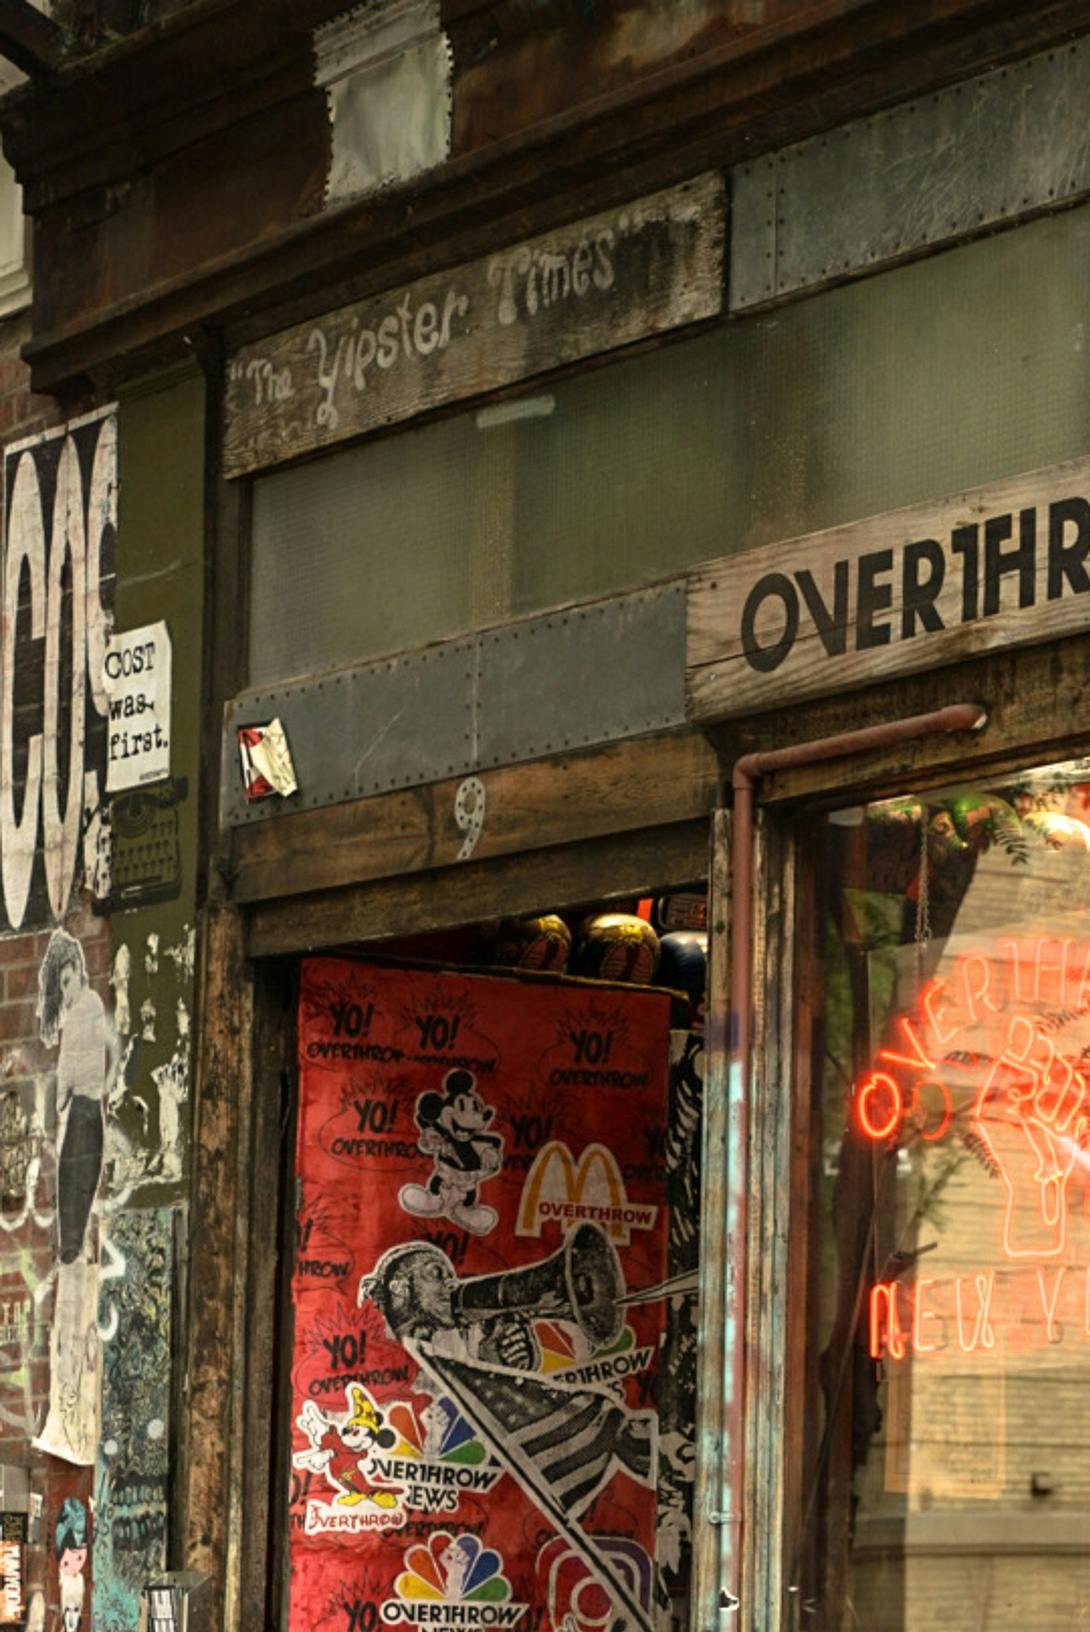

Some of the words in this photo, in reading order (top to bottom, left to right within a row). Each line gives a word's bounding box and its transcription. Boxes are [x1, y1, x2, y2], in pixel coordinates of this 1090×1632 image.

[307, 292, 469, 429] Yipster
[104, 641, 156, 680] COST
[109, 723, 168, 761] first.
[454, 776, 486, 861] 9
[330, 1003, 375, 1038] YO!
[415, 1014, 460, 1050] YO!
[569, 1029, 614, 1065] YO!
[353, 1099, 398, 1134] YO!
[331, 1138, 429, 1159] OVERTHRO
[538, 1202, 652, 1225] OVERTHROW
[869, 1270, 996, 1361] NEW
[323, 1329, 367, 1370] YO!
[552, 1347, 655, 1383] ERTHROW
[309, 1504, 406, 1531] OVERTHROW
[381, 1602, 523, 1627] OVERTHROW
